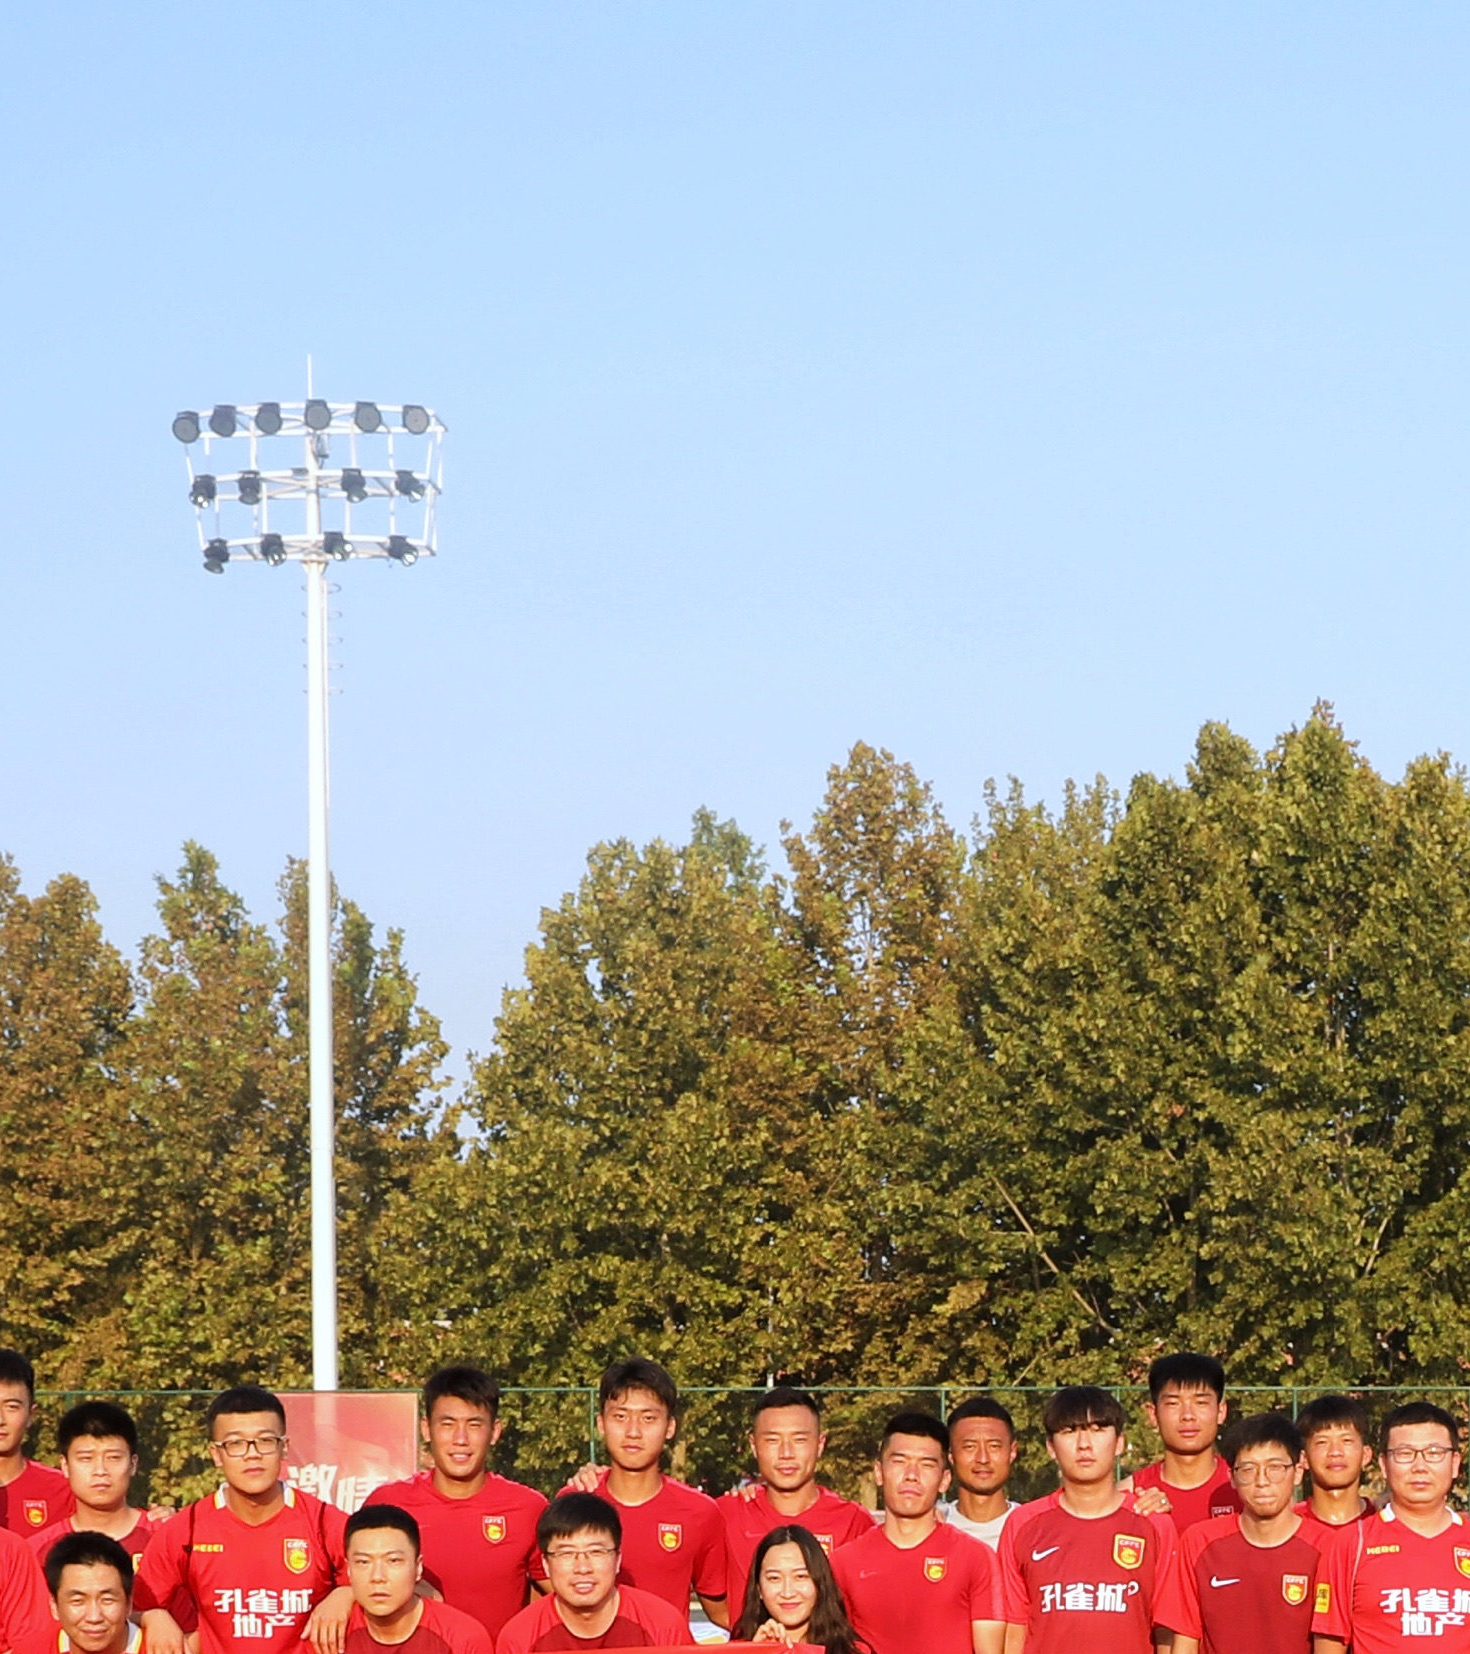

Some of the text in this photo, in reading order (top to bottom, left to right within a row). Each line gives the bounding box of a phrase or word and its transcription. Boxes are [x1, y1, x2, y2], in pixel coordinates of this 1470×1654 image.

[214, 1589, 313, 1613] 孔雀城
[233, 1613, 295, 1638] 地产
[1401, 1612, 1466, 1636] 地产
